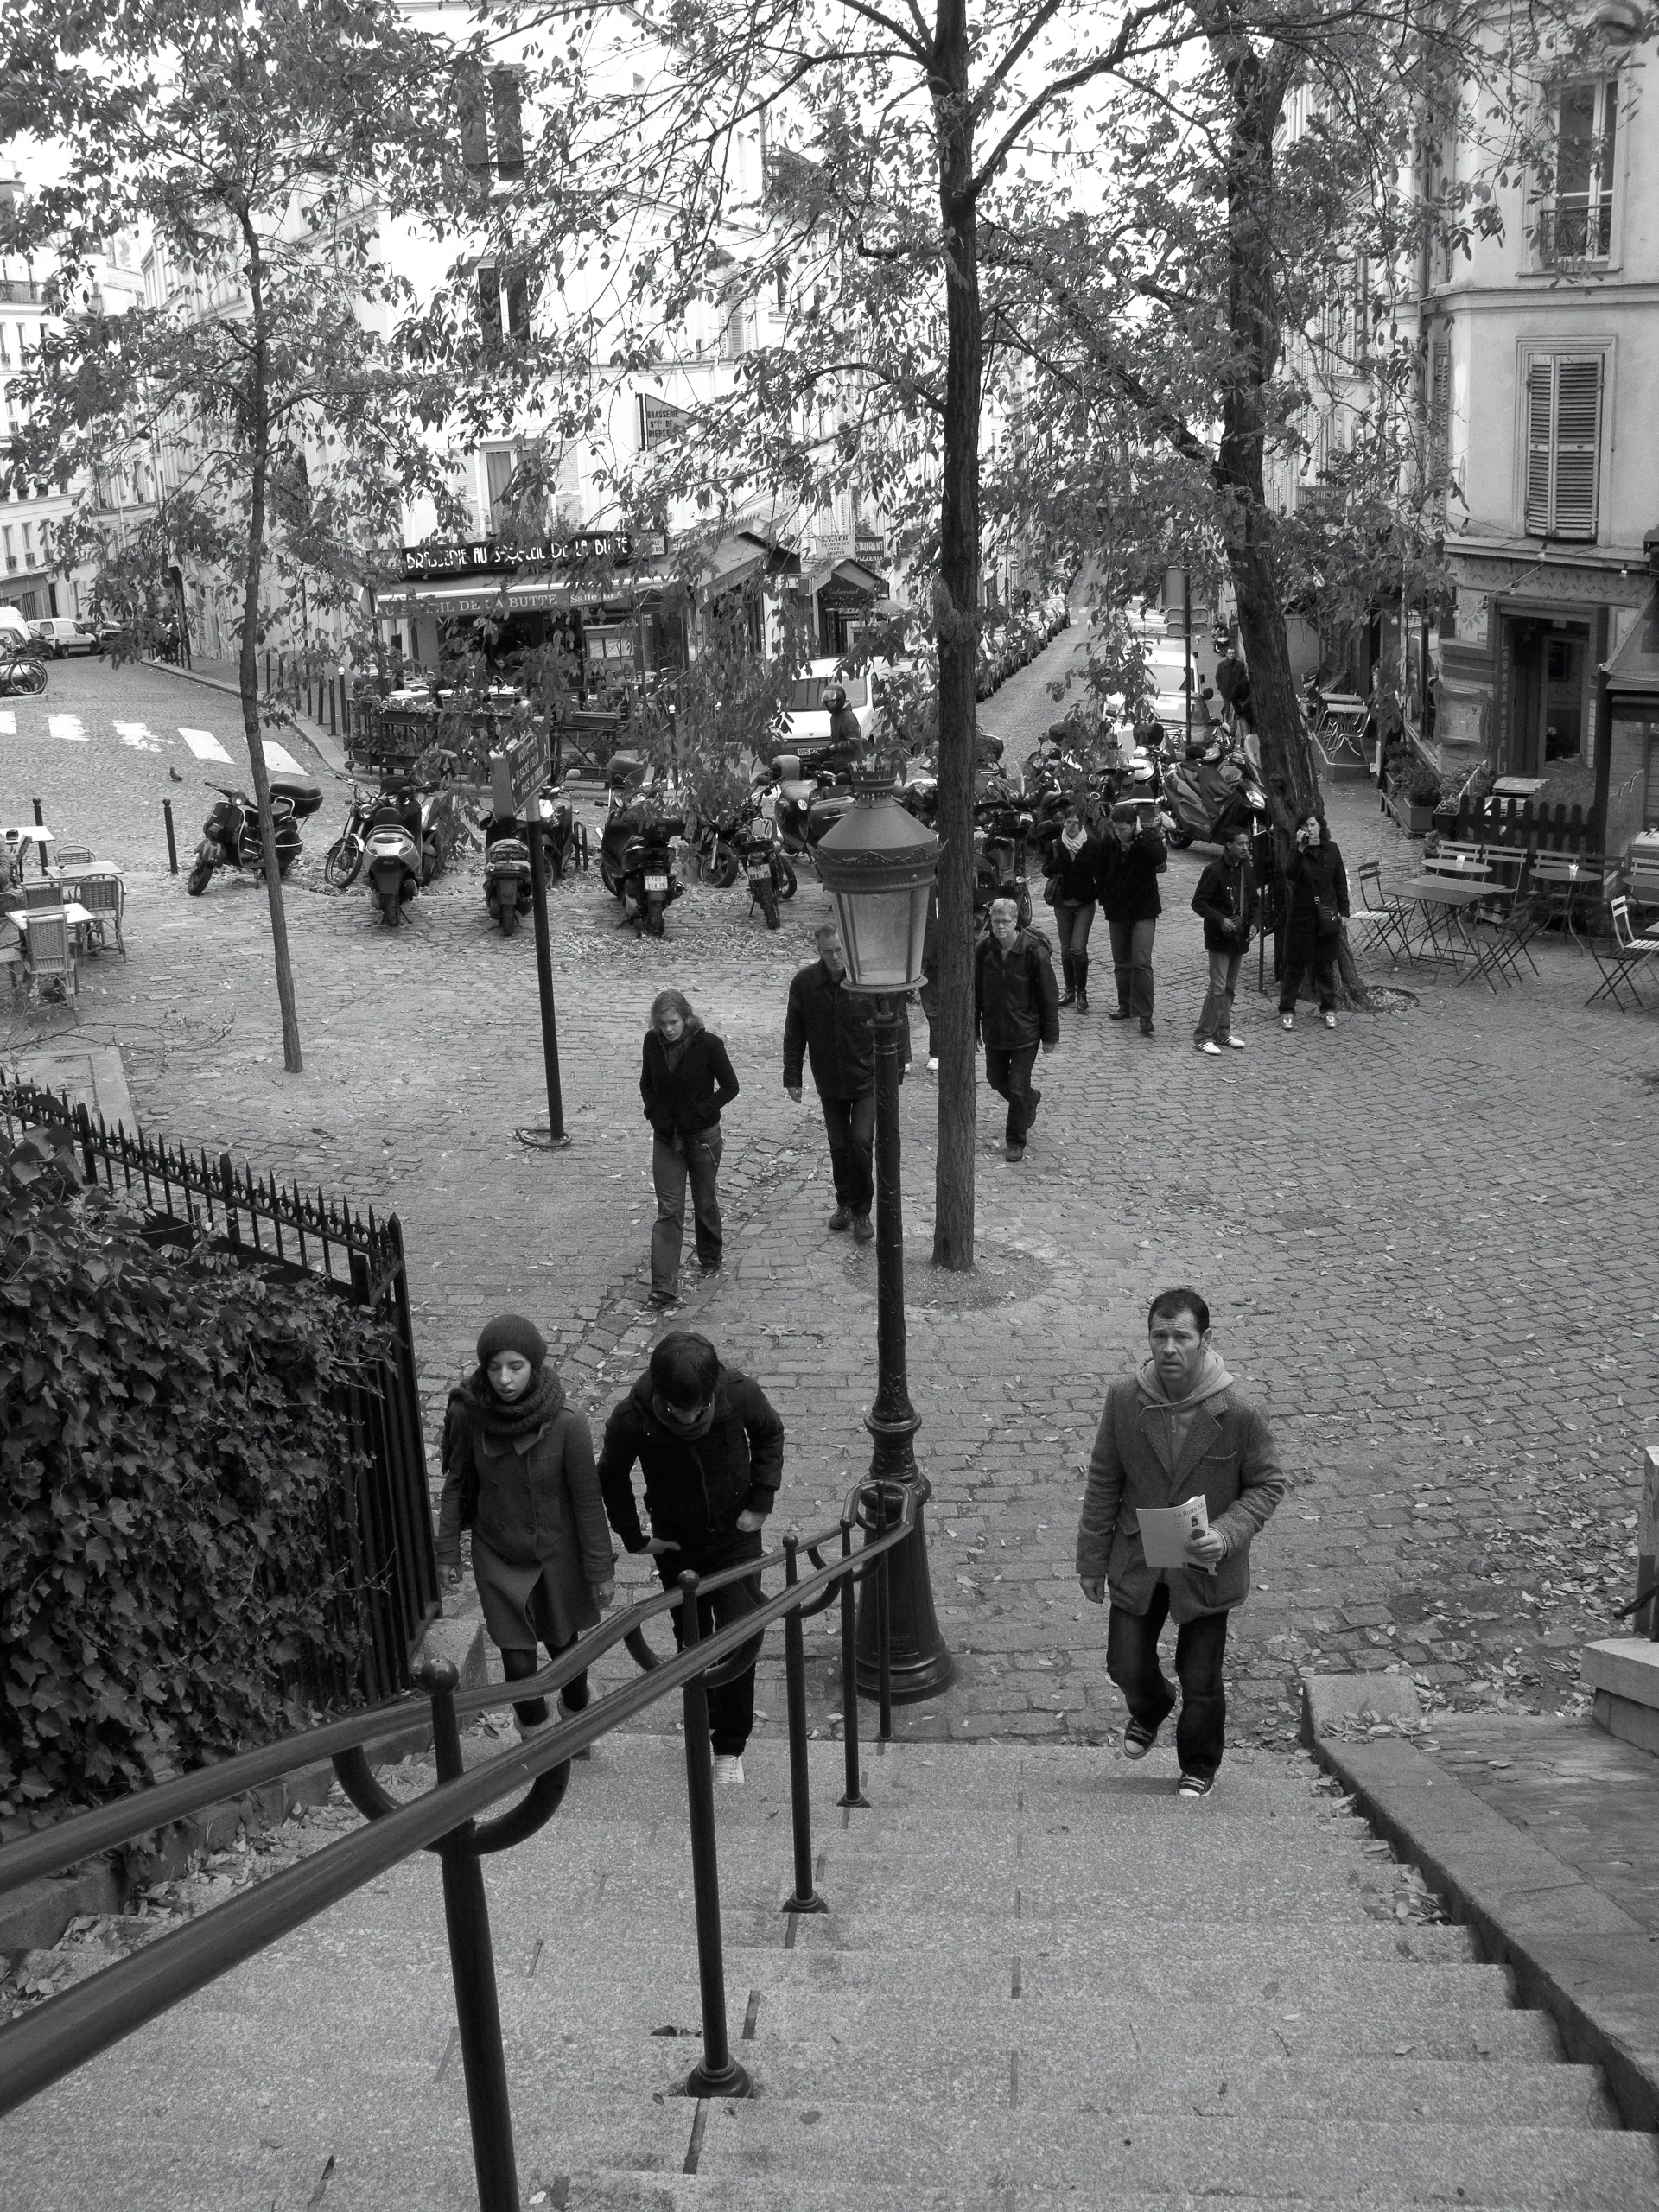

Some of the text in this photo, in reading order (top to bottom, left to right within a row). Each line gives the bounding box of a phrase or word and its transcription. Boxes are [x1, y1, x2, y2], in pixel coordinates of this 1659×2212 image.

[1298, 490, 1344, 504] RETAURANT
[473, 546, 487, 564] AU
[594, 537, 628, 556] BUTE
[855, 541, 883, 552] STAURANT
[459, 600, 480, 611] DE
[508, 594, 558, 608] BUTTE
[570, 593, 597, 603] Salle
[1182, 1507, 1198, 1516] Butte
